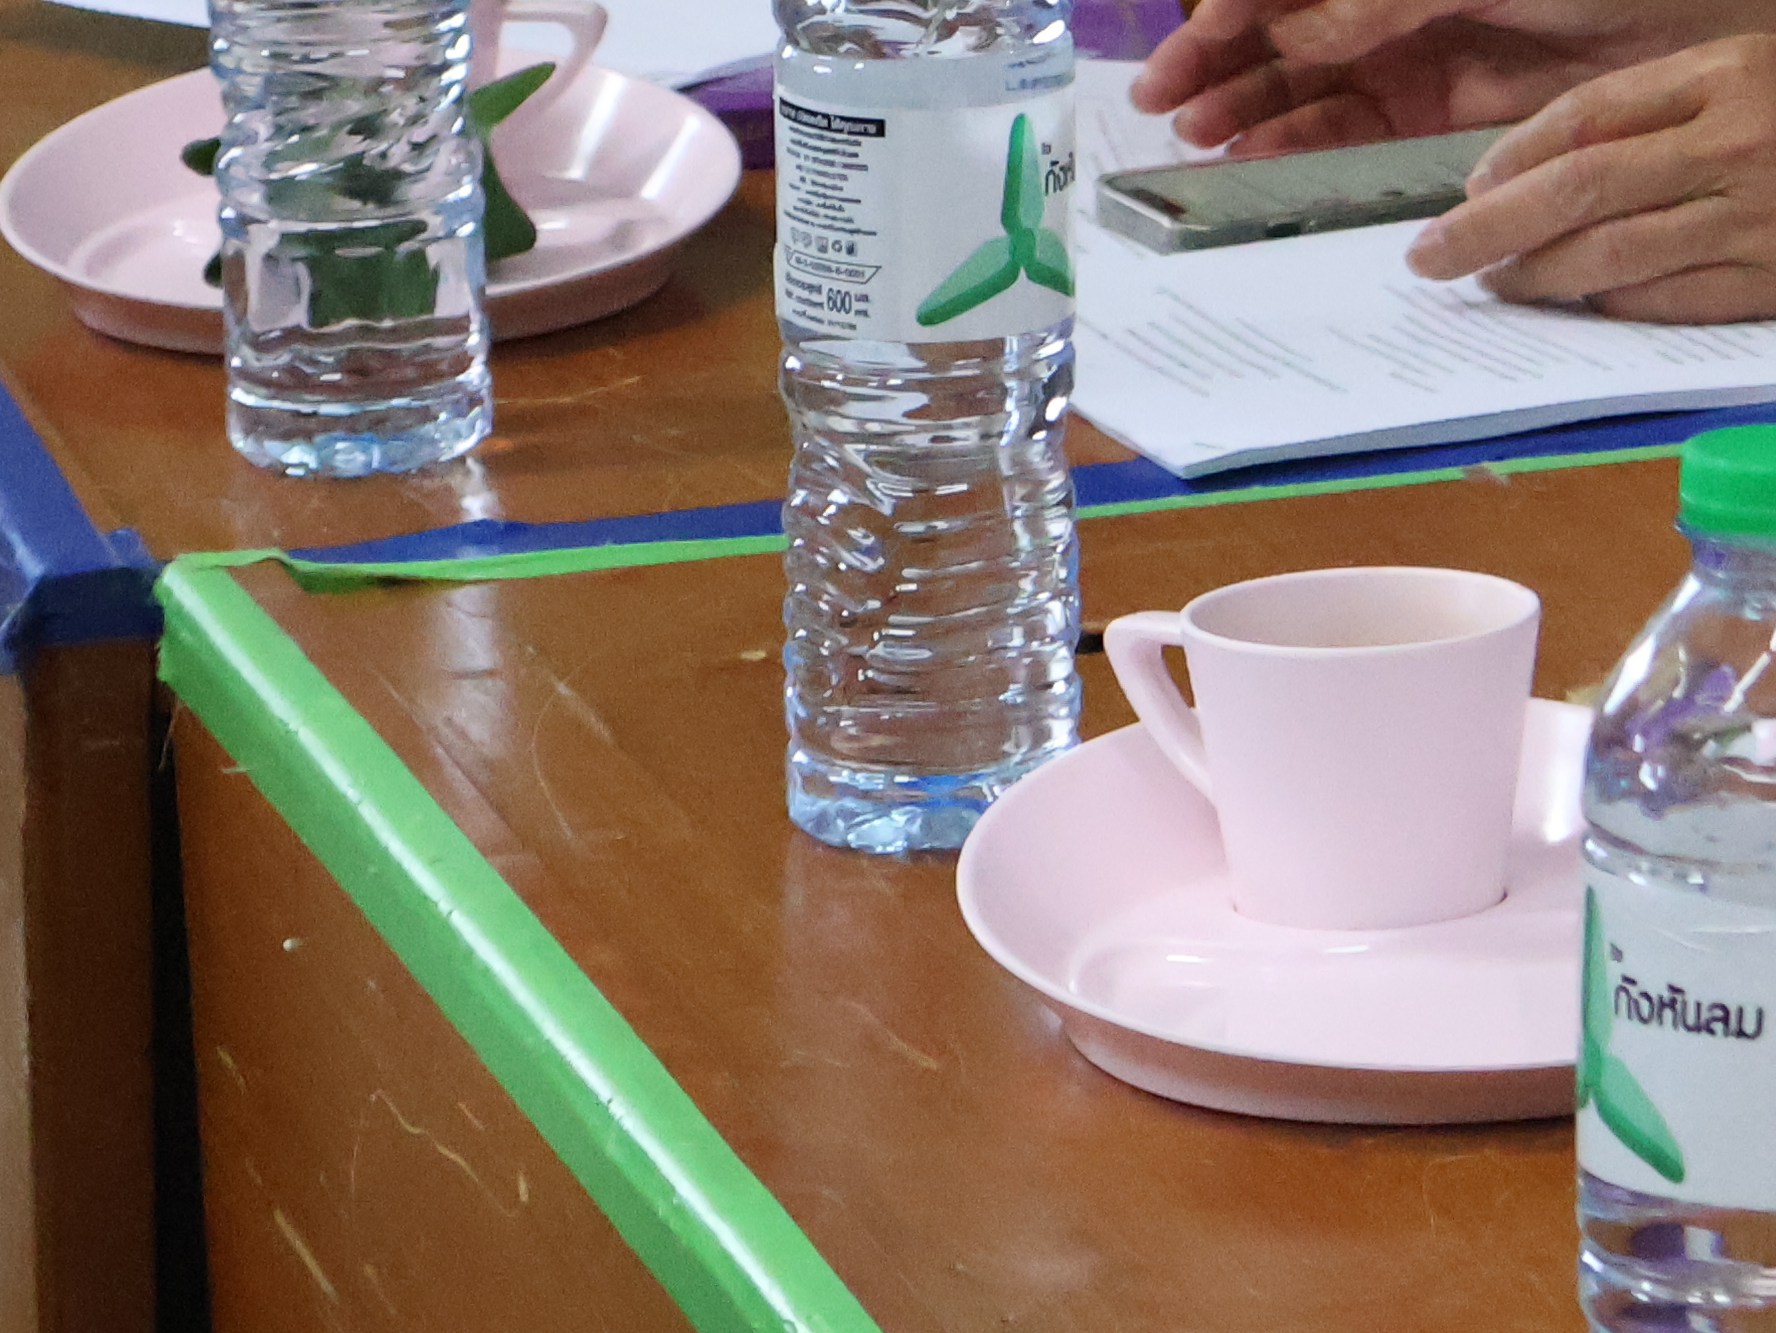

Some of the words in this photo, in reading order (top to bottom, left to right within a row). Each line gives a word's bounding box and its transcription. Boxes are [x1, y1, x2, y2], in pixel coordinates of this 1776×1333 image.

[827, 287, 852, 315] 600
[1613, 973, 1765, 1040] กังหันลม
